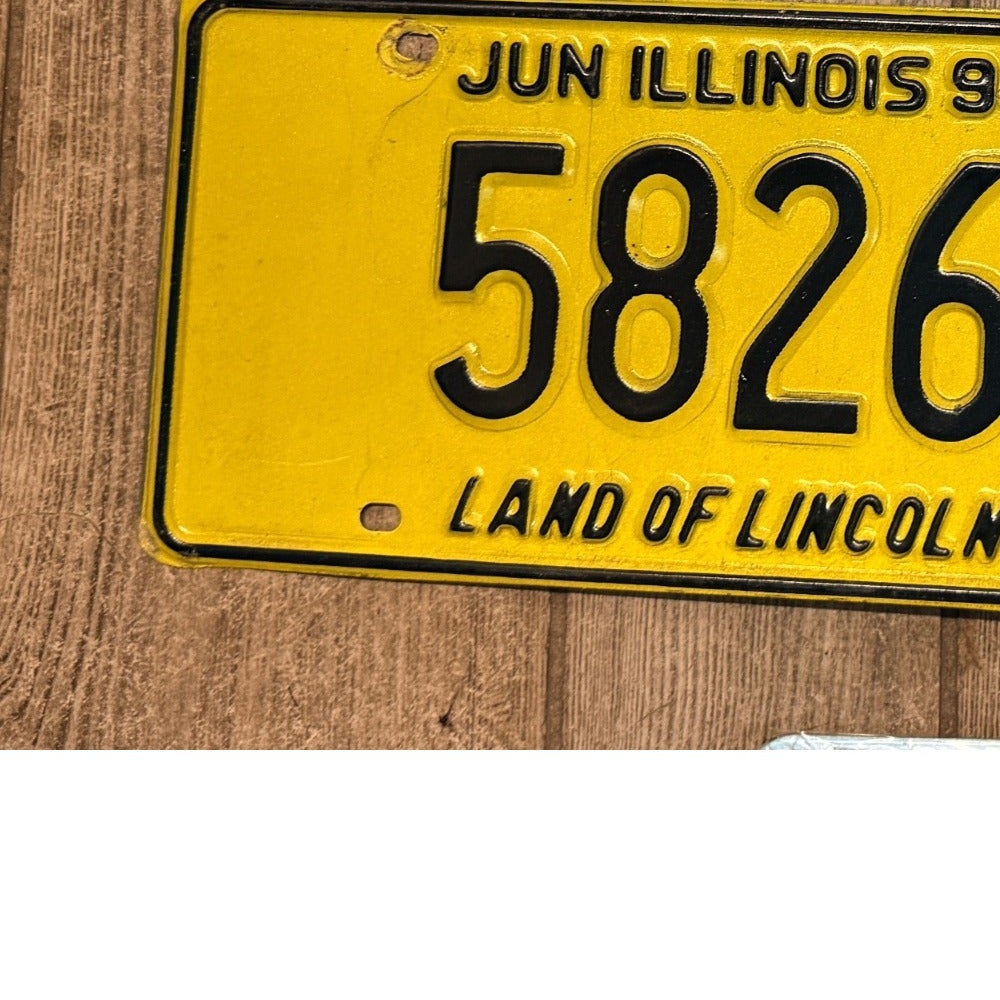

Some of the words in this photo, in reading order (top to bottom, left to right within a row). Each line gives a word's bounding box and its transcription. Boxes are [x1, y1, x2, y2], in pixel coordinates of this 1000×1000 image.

[458, 41, 603, 96] JUN
[630, 46, 928, 111] ILLINOIS
[449, 477, 626, 540] LAND
[643, 484, 731, 545] OF
